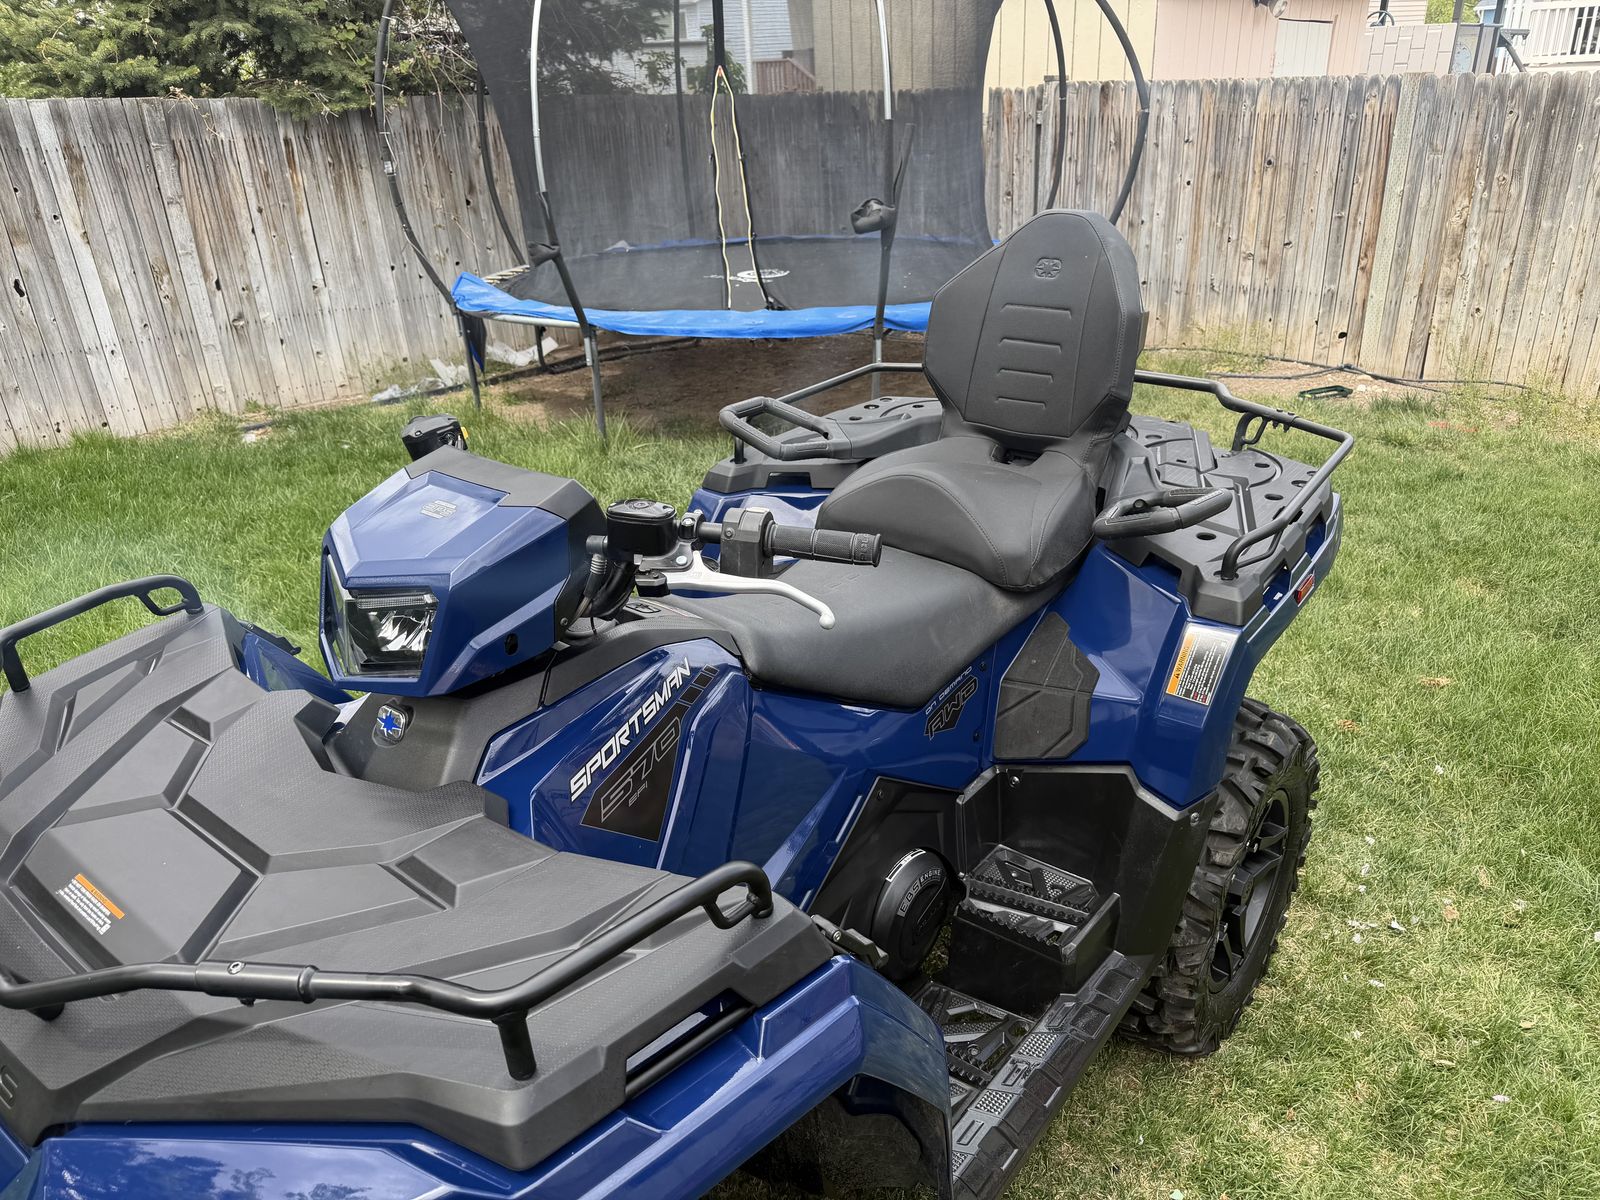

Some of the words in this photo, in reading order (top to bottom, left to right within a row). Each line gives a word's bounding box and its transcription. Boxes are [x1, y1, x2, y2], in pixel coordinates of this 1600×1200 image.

[570, 657, 691, 802] SPORTSMAN
[928, 676, 978, 741] AWD
[600, 716, 682, 823] 570
